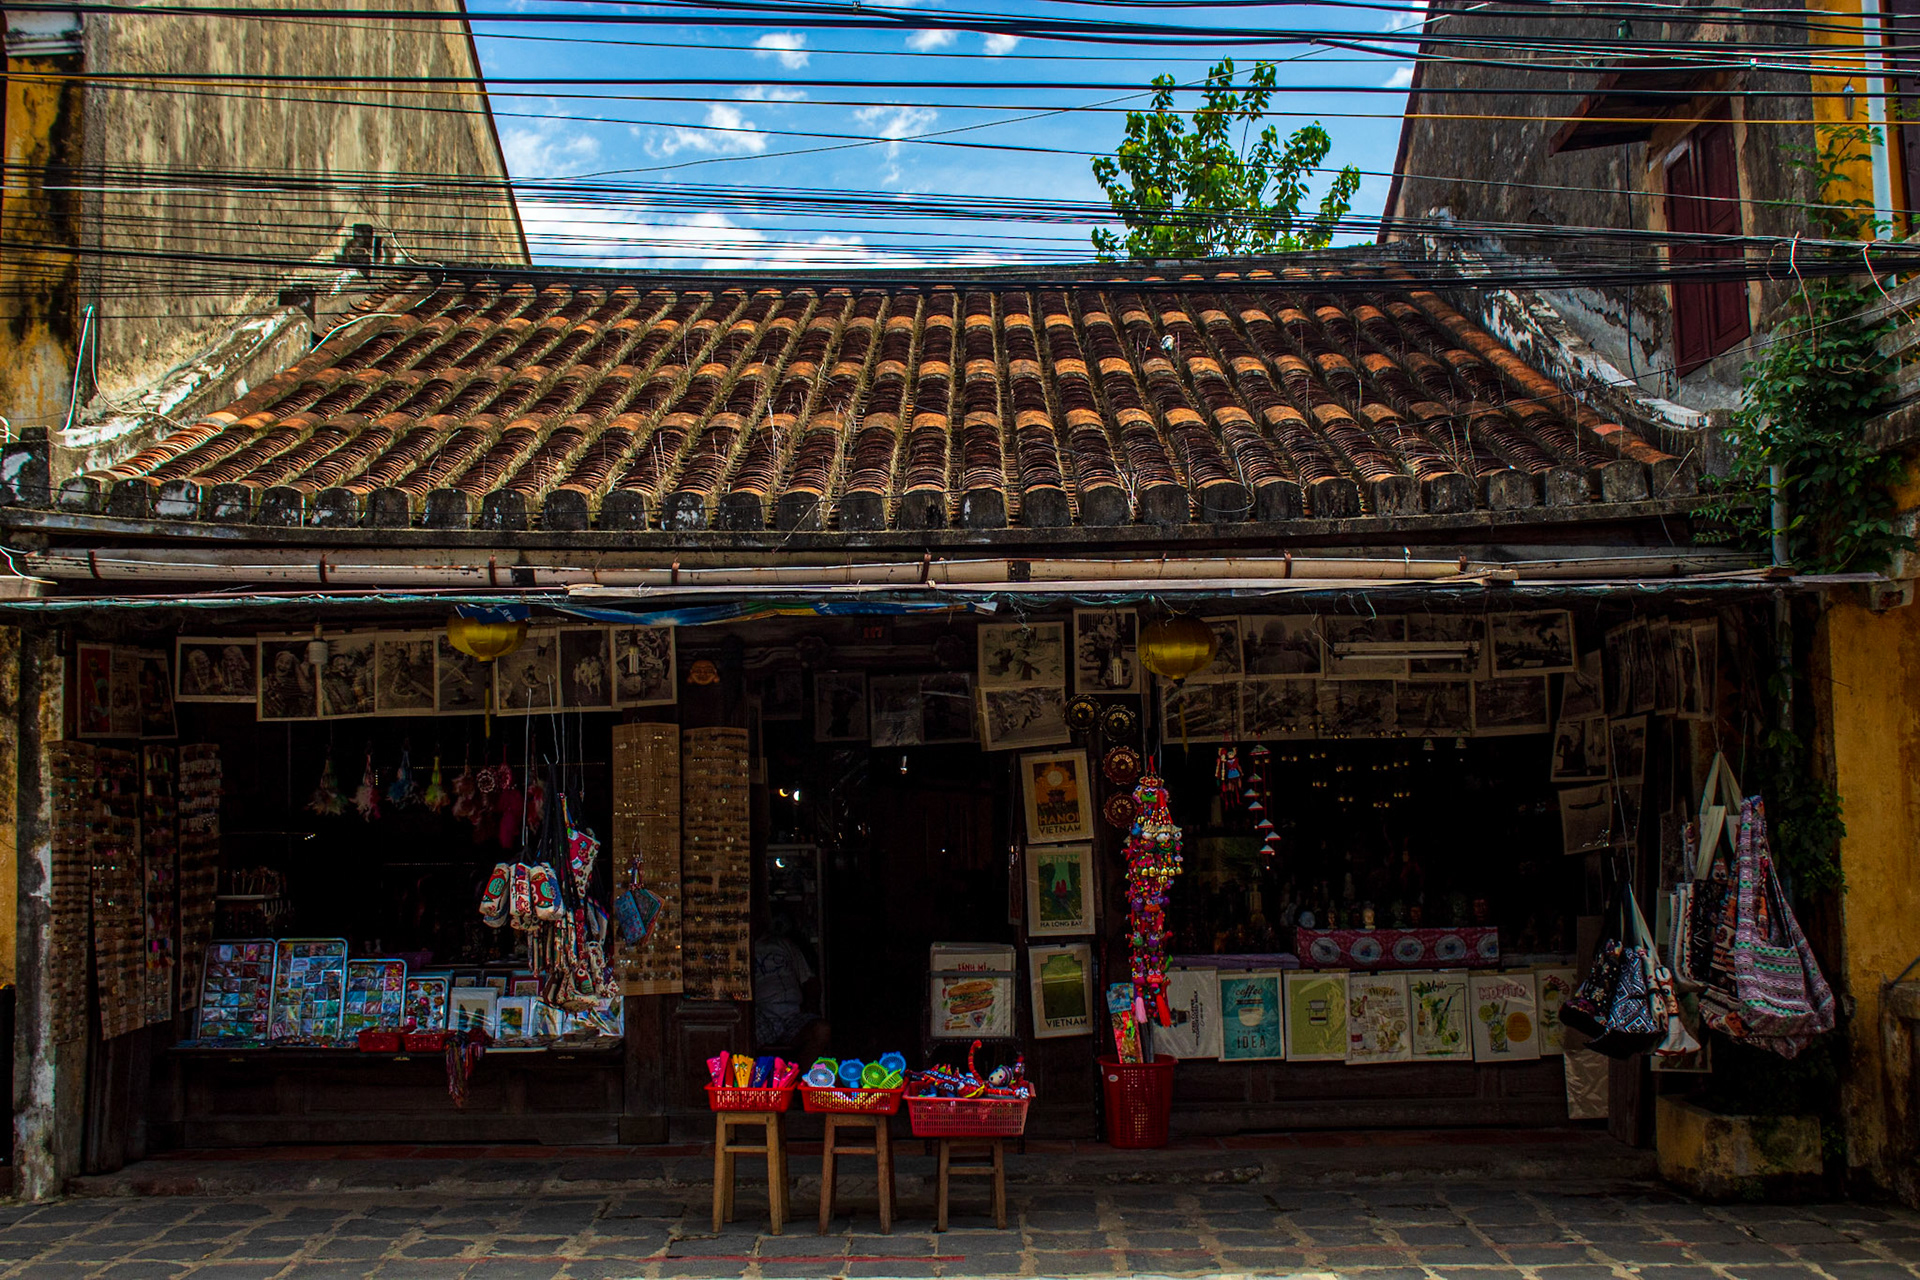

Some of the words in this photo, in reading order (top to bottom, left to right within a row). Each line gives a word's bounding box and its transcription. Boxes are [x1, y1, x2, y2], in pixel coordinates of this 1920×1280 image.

[1038, 812, 1080, 825] HANOI
[1038, 824, 1081, 834] VIETNAM
[1038, 855, 1080, 864] VIETNAM
[1045, 1017, 1088, 1028] VIETNAM
[1237, 1035, 1266, 1049] IDEA
